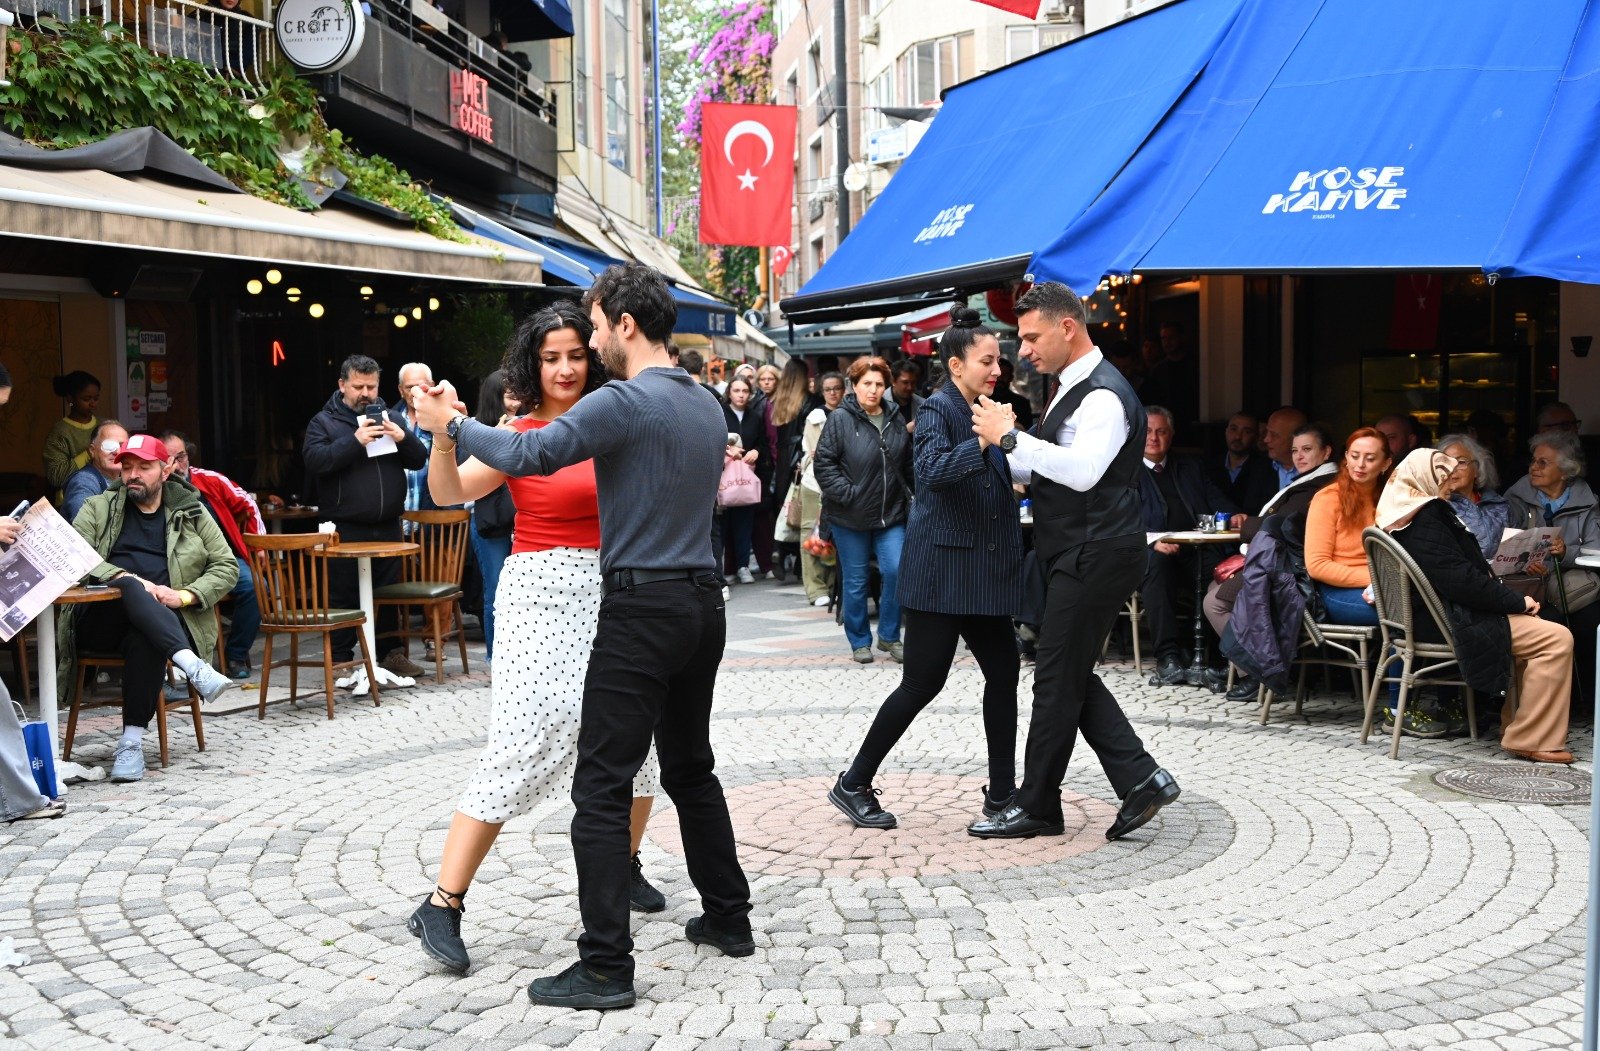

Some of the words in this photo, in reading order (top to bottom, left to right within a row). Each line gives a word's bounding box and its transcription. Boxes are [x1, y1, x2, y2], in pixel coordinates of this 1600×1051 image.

[284, 18, 344, 34] CROFT
[462, 69, 488, 113] MET
[460, 103, 494, 144] COFFEE
[1262, 188, 1408, 214] KAHVE
[727, 477, 752, 486] addax
